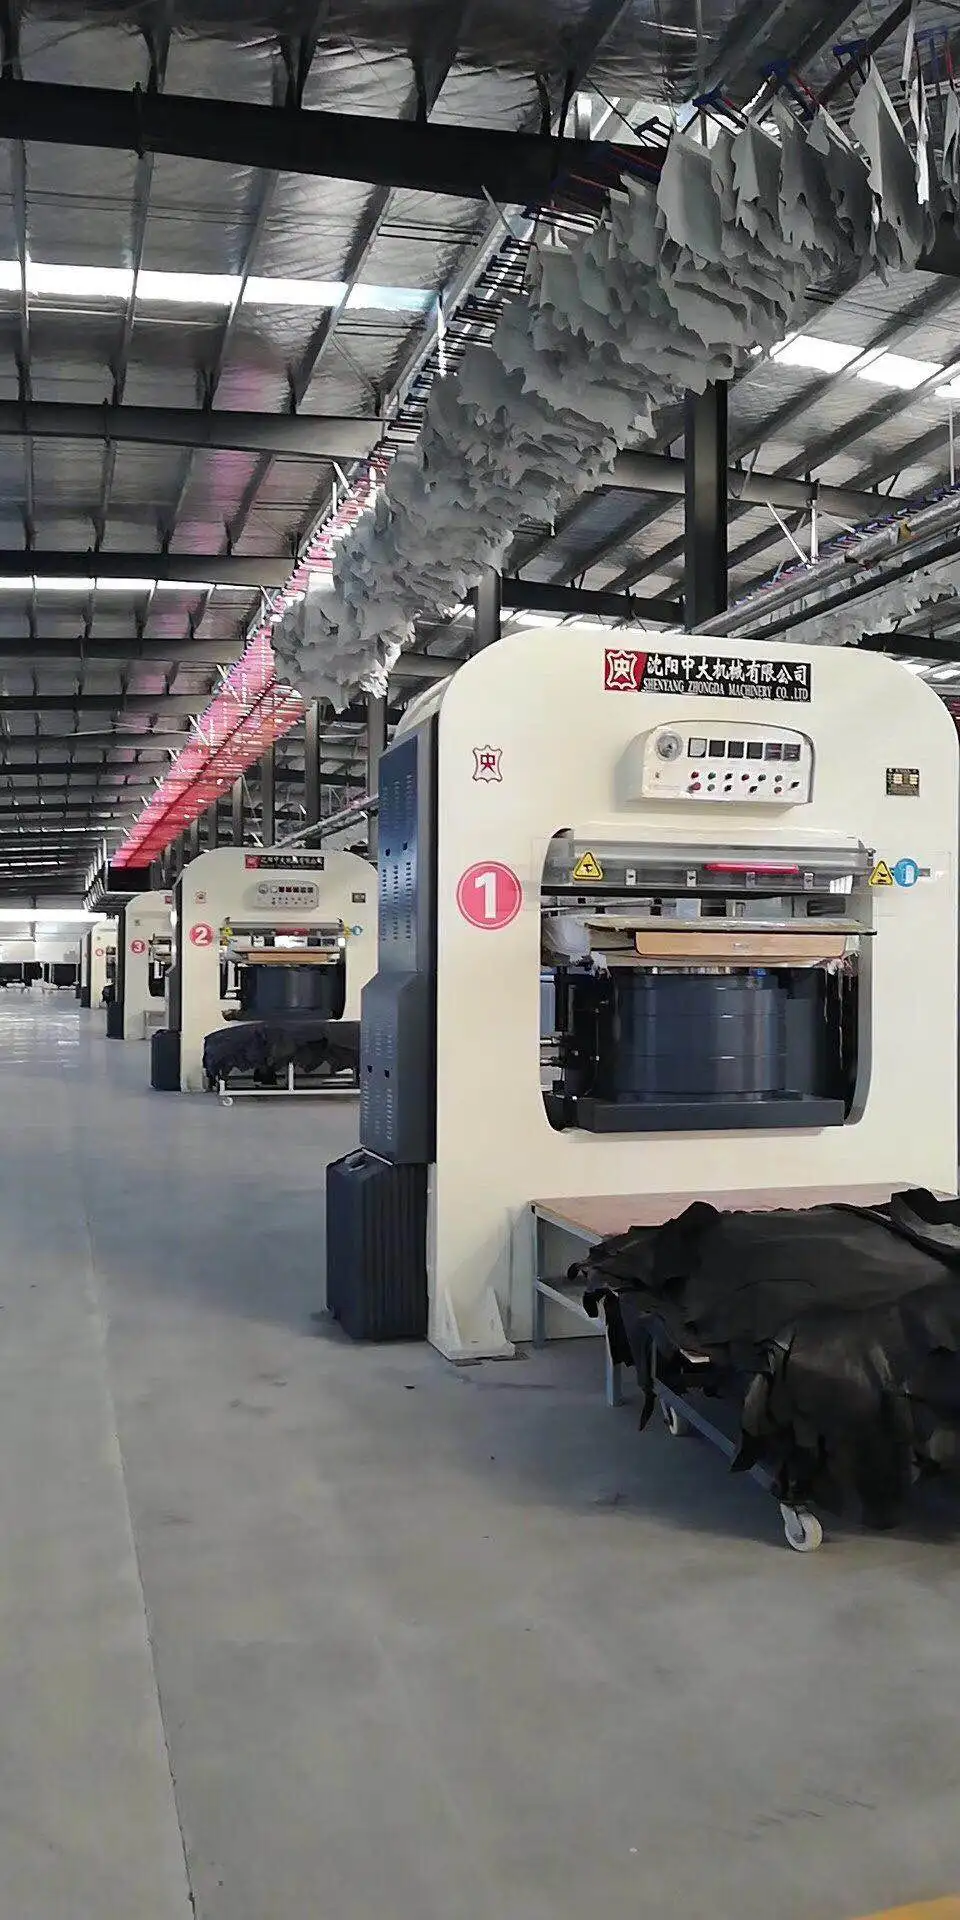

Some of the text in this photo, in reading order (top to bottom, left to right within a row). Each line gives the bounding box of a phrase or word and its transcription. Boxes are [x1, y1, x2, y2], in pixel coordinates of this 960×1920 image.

[646, 653, 807, 686] 沈阳中大机械有限公司
[643, 677, 685, 692] SHENYANG
[687, 680, 725, 695] ZHONGDA
[728, 683, 773, 698] MACHINERY
[475, 871, 497, 919] 1
[194, 926, 209, 944] 2
[133, 941, 143, 953] 3
